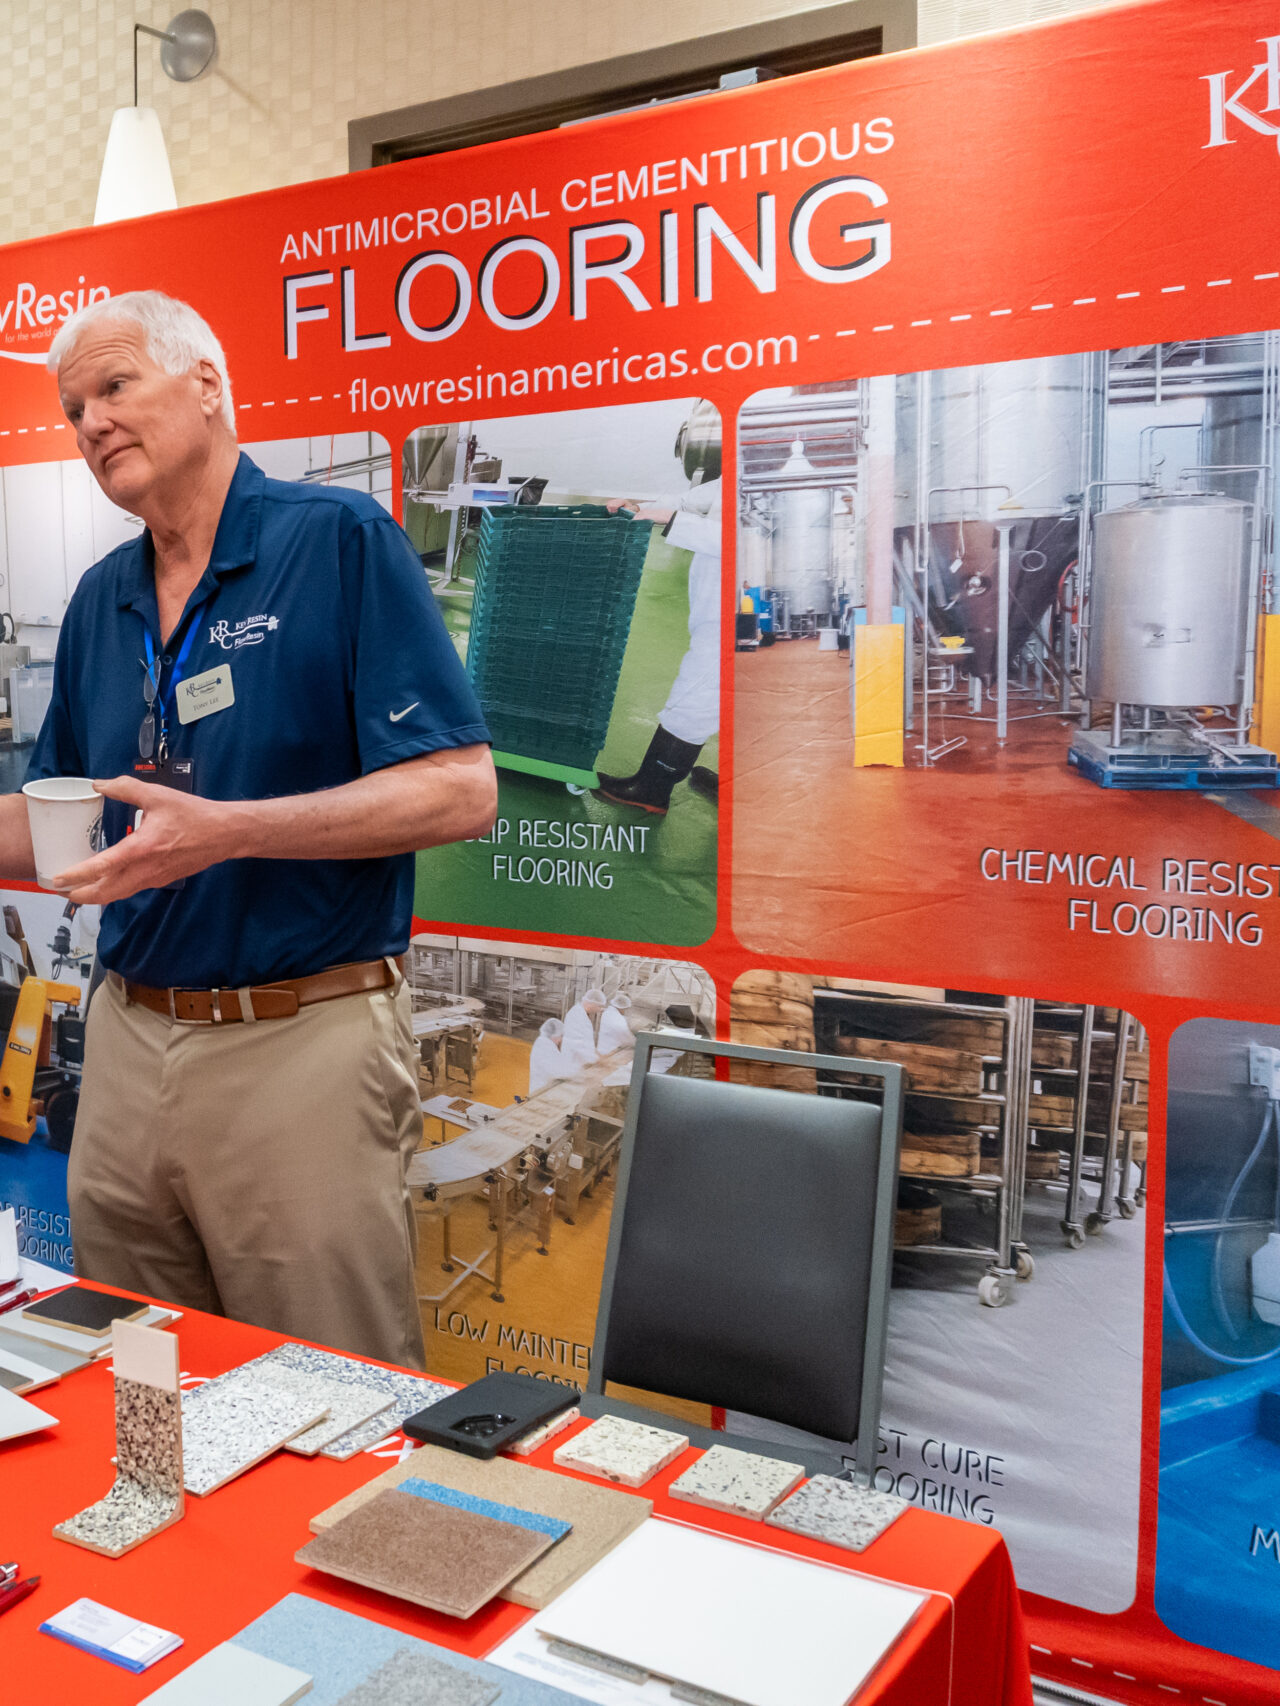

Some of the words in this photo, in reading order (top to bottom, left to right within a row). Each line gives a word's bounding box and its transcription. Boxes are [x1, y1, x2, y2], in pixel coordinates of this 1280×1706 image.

[280, 187, 550, 263] ANTIMICROBIAL
[560, 117, 895, 212] CEMENTITIOUS
[283, 175, 893, 359] FLOORING
[349, 333, 799, 413] flowresinamericas.com
[519, 820, 650, 853] RESISTANT
[493, 854, 614, 889] FLOORING
[980, 847, 1147, 890] CHEMICAL
[1068, 898, 1263, 946] FLOORING
[19, 1205, 72, 1238] RESIST
[434, 1306, 489, 1344] LOW
[497, 1324, 592, 1371] MAINTE
[921, 1438, 1004, 1487] CURE
